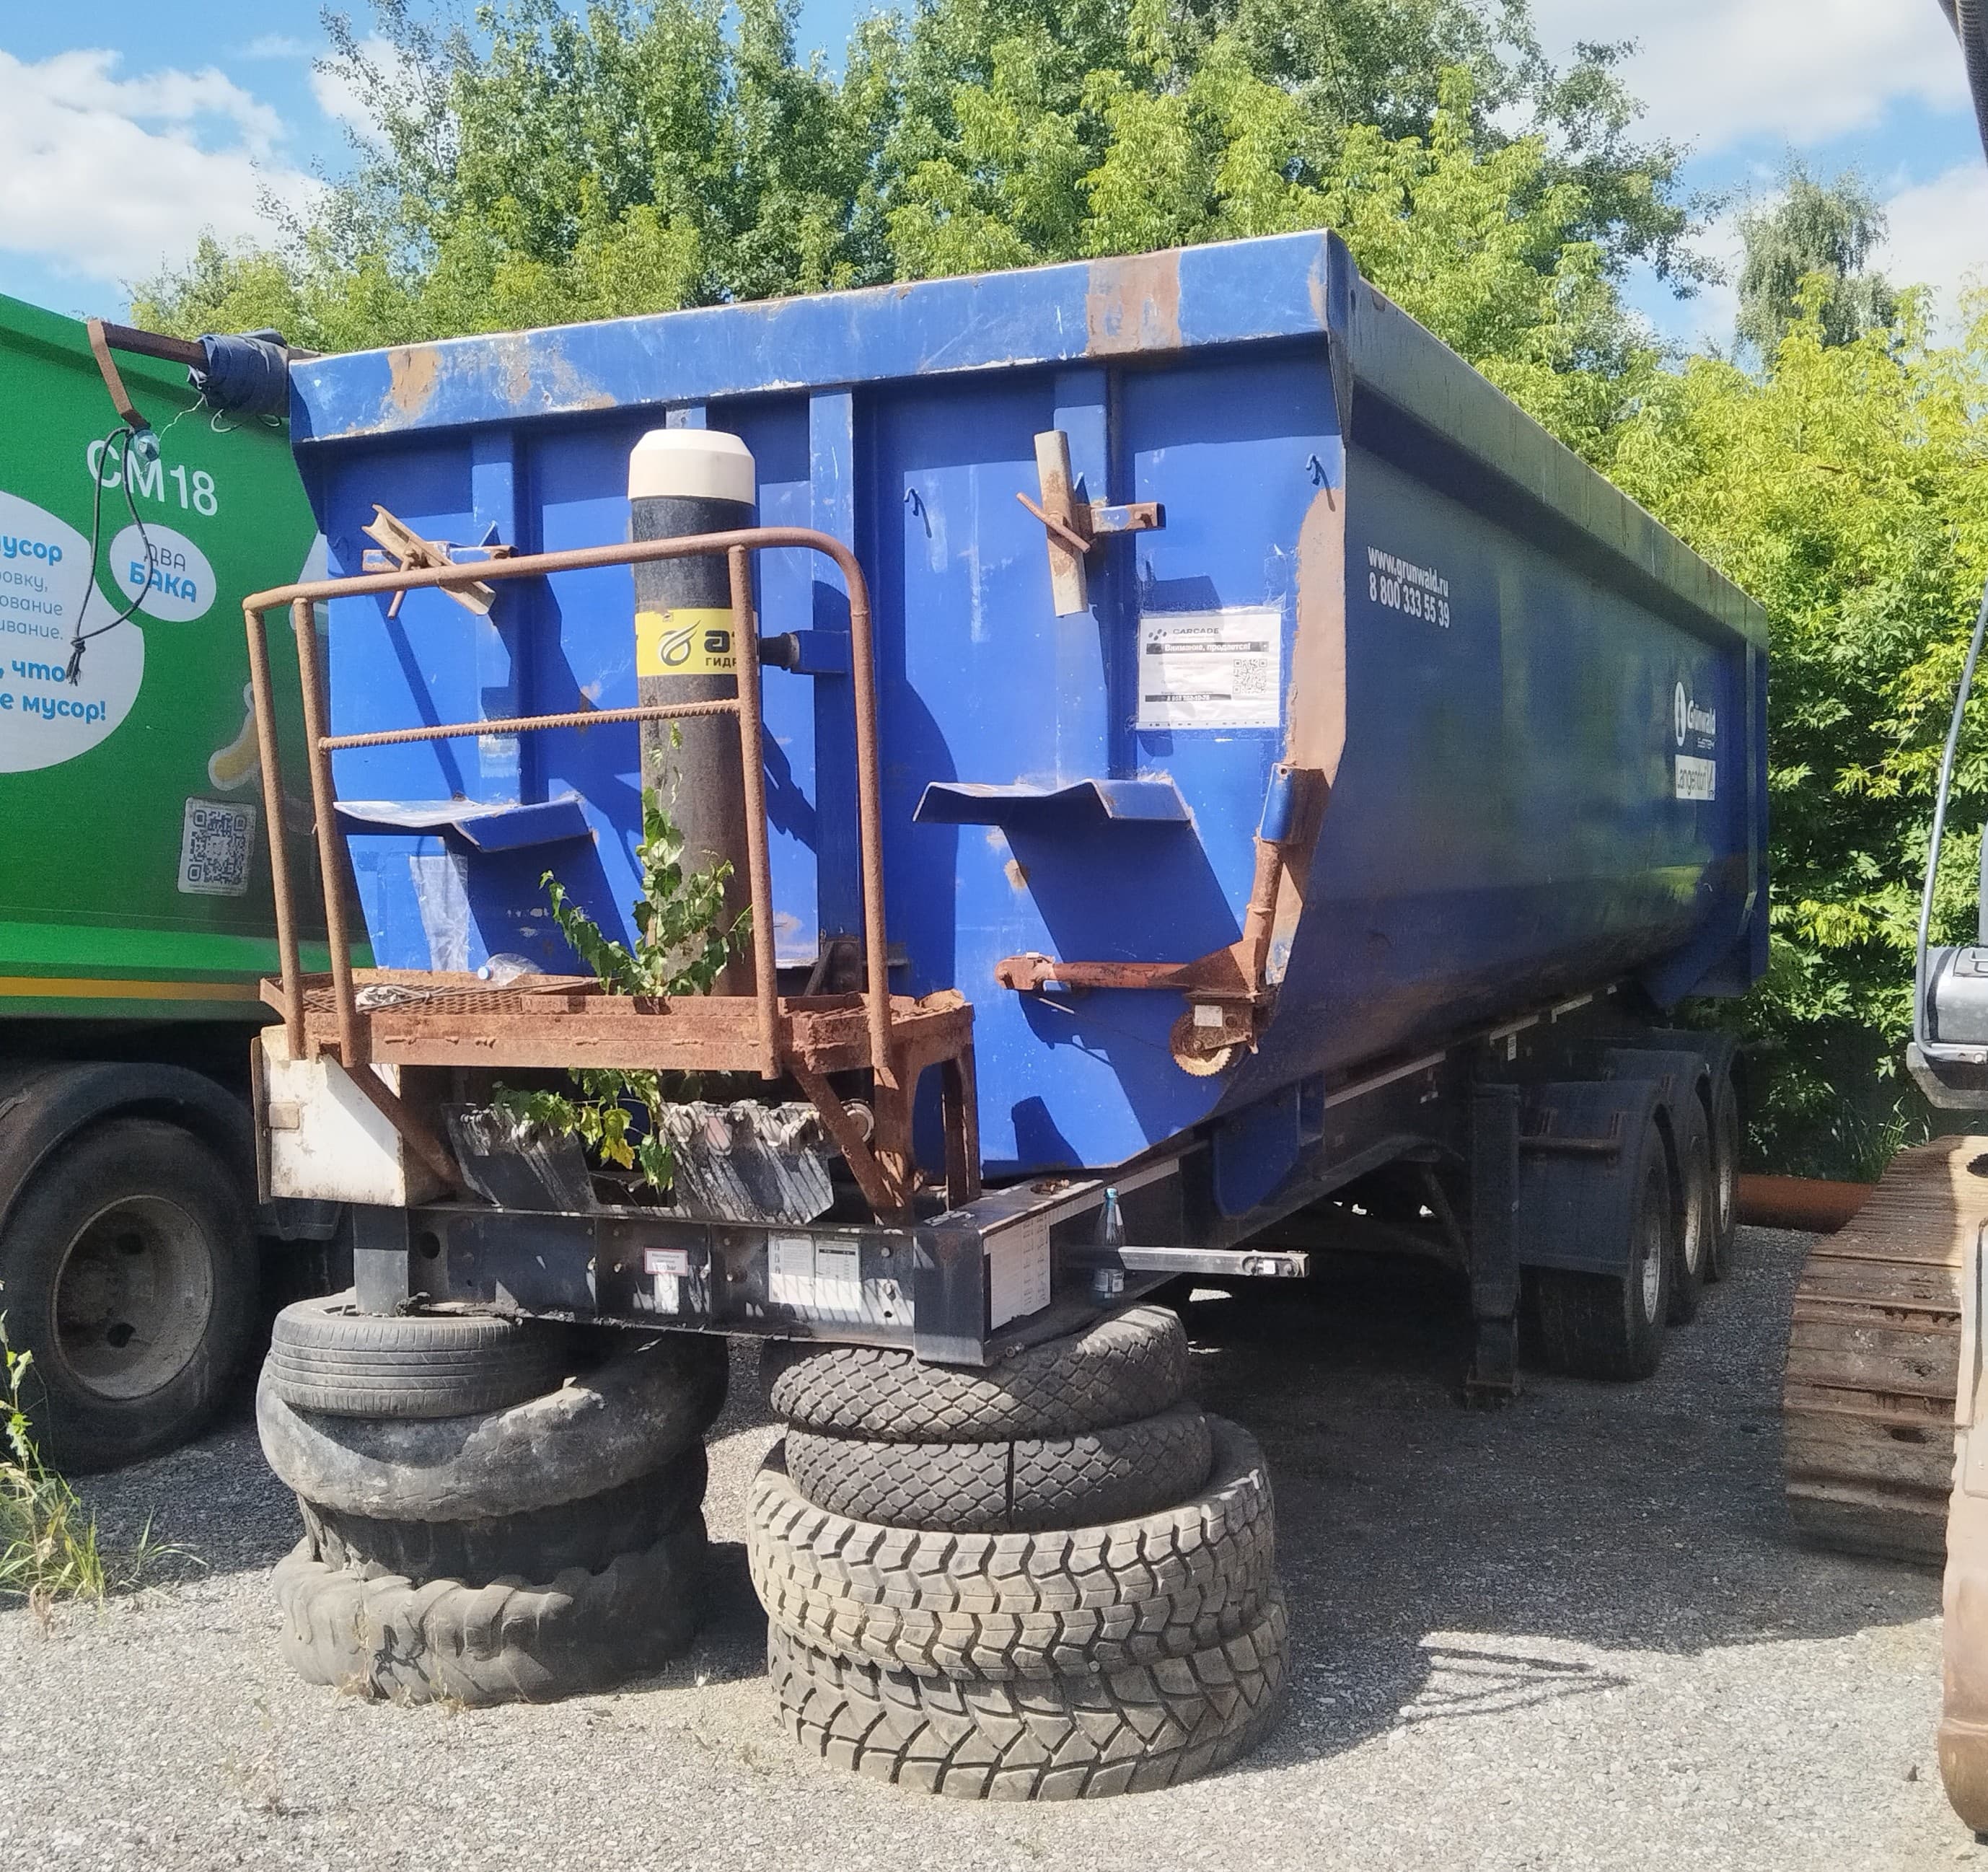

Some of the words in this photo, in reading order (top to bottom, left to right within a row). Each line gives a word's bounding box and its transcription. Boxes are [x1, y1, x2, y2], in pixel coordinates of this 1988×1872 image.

[0, 535, 63, 566] усор
[144, 543, 185, 572] ДВА
[0, 570, 48, 593] овку,
[129, 561, 197, 603] БАКА
[1368, 546, 1448, 598] www.grunwald.ru
[1369, 572, 1377, 602] 8
[1380, 576, 1401, 610] 800
[1403, 585, 1421, 618] 333
[1424, 594, 1436, 623] 55
[1438, 599, 1450, 629] 39
[12, 659, 66, 682] что
[22, 695, 106, 724] мусор!
